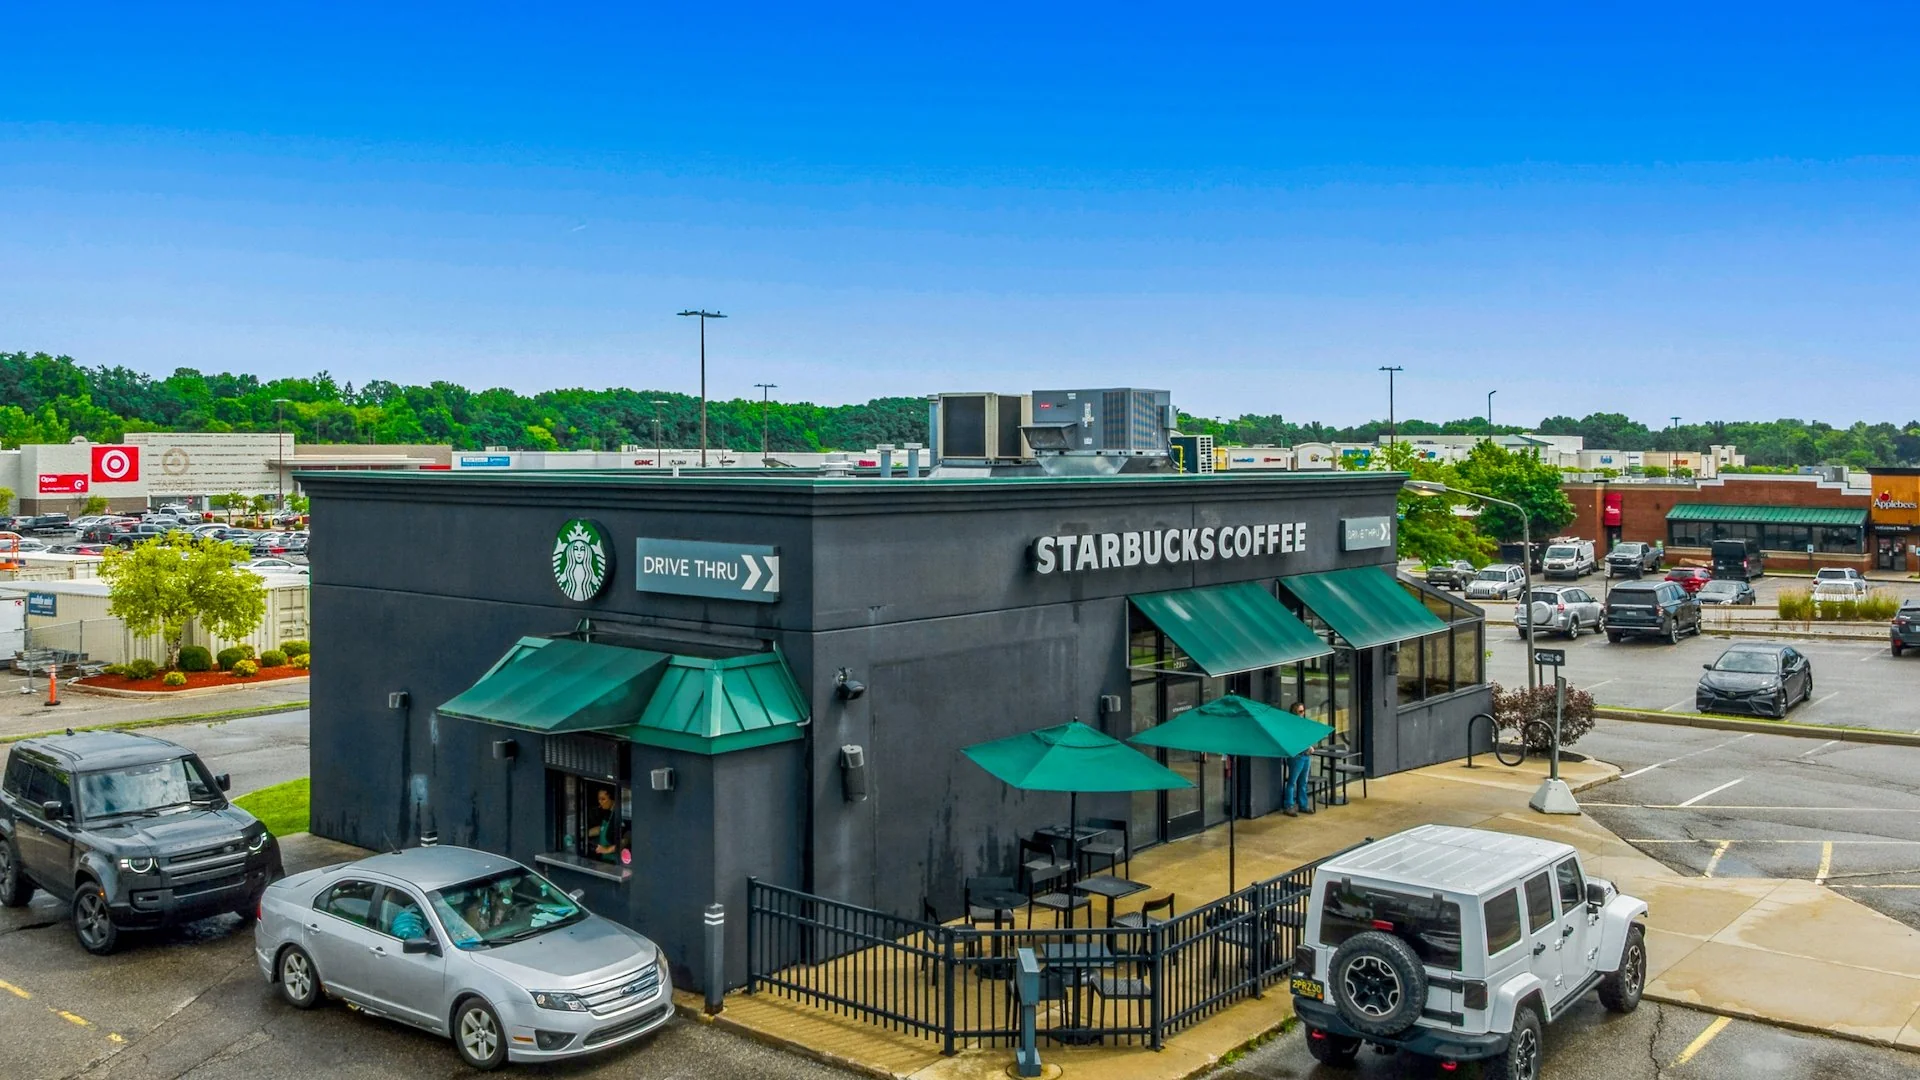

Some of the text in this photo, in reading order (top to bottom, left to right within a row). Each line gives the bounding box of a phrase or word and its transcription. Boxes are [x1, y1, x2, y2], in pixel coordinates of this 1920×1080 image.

[643, 555, 739, 582] DRIVE THRU
[1036, 522, 1308, 575] STARBUCKS COFFEE
